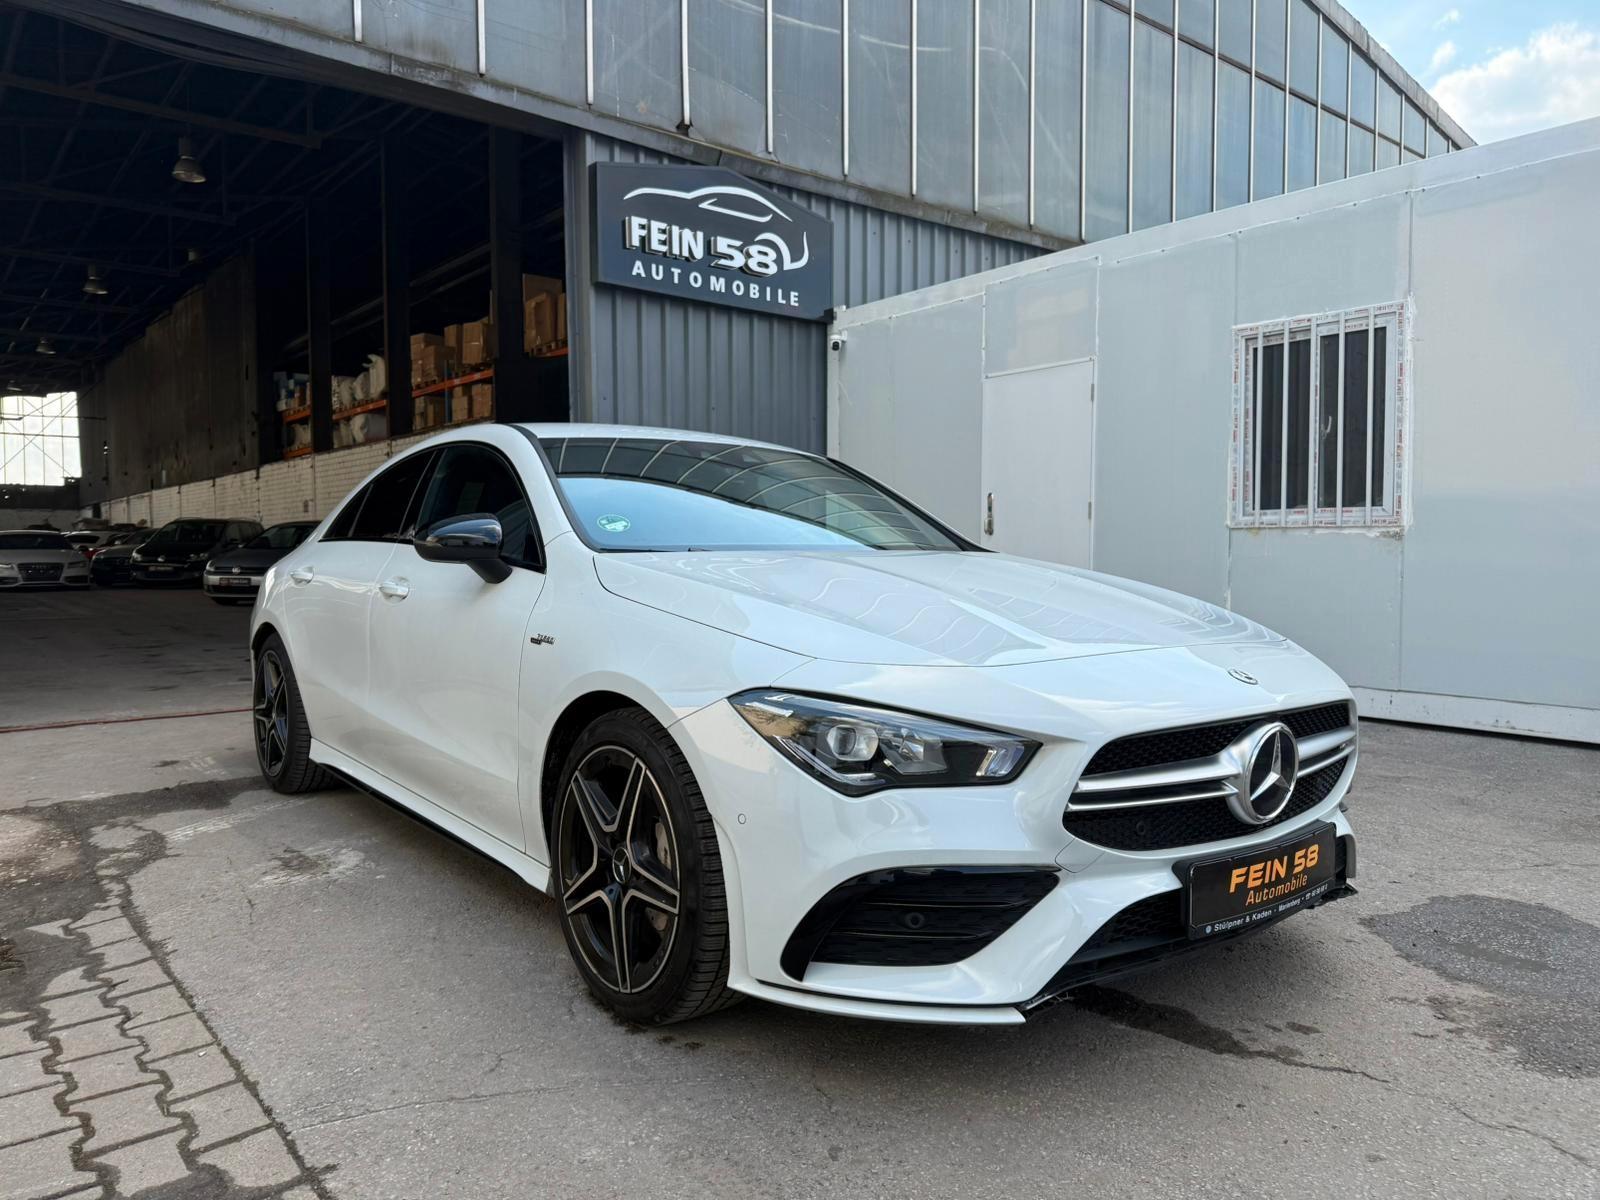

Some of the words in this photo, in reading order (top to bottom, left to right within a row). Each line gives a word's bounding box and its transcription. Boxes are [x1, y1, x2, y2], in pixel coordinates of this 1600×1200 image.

[625, 215, 704, 262] FEIN
[711, 236, 778, 278] 58
[632, 260, 799, 307] AUTOMOBILE
[1229, 856, 1288, 894] FEIN
[1293, 844, 1319, 875] 58
[1245, 873, 1308, 906] Automobile
[1252, 909, 1272, 921] Kaden
